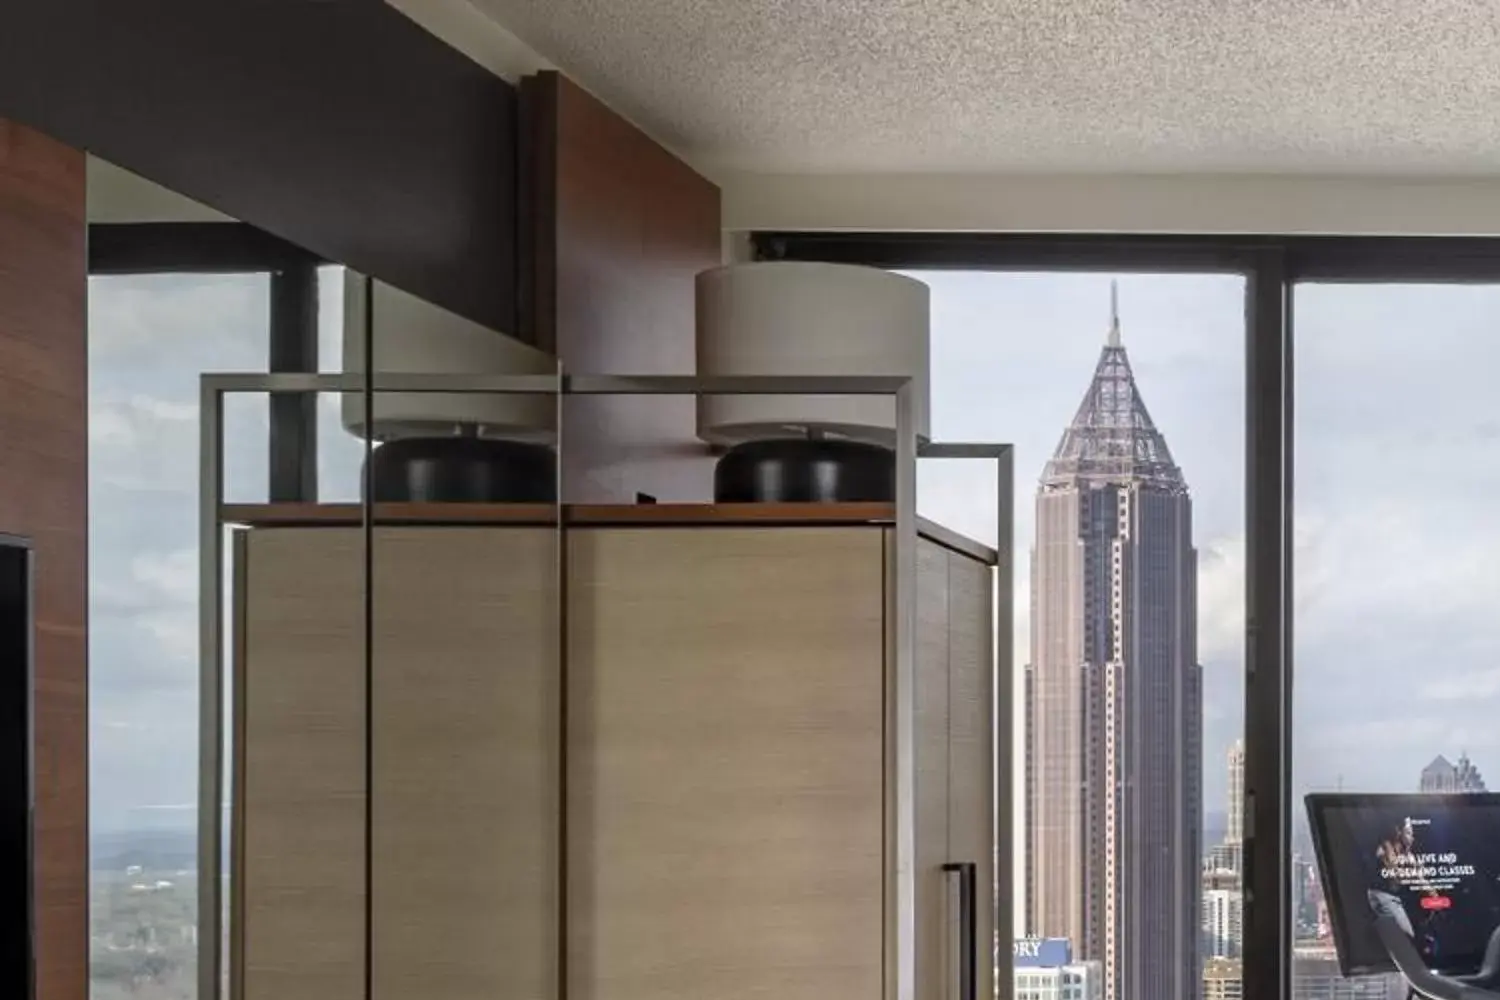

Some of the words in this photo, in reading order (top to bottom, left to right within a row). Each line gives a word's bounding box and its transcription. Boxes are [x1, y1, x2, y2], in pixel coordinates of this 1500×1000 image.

[1417, 853, 1437, 865] LIVE
[1438, 852, 1458, 864] AND
[1438, 865, 1475, 876] CLASSES
